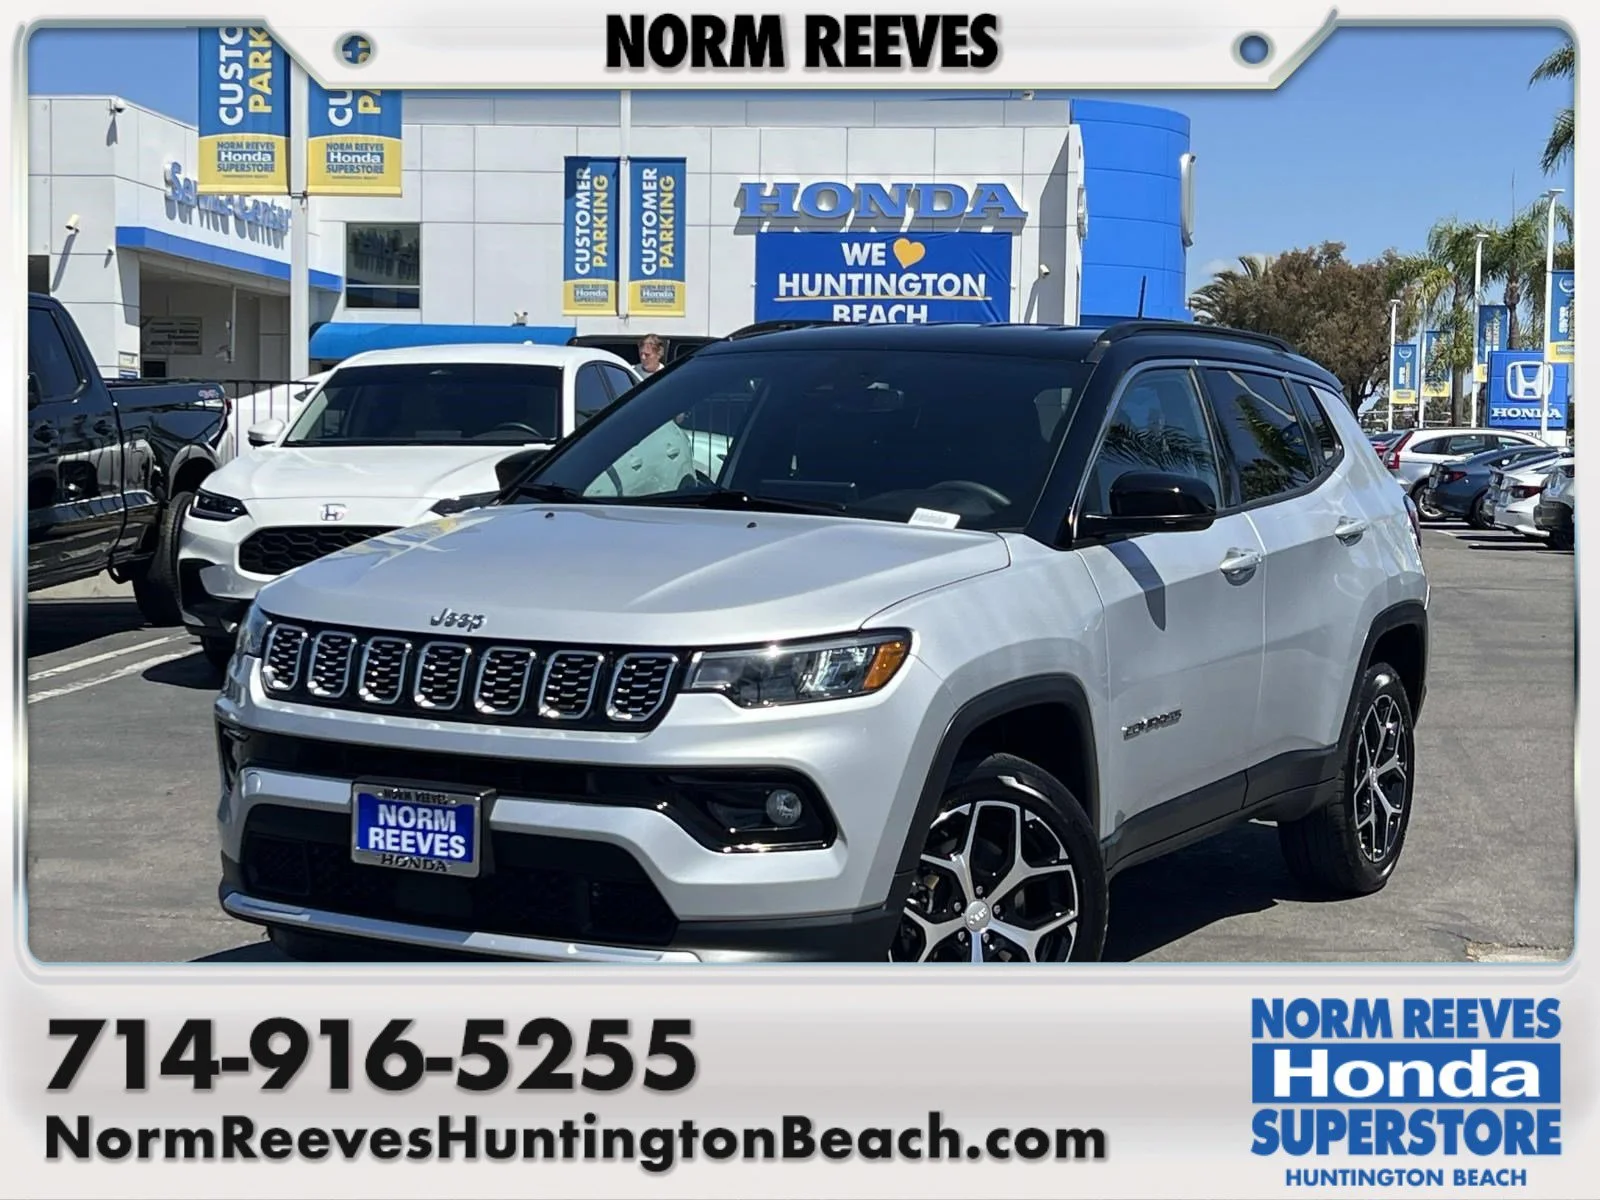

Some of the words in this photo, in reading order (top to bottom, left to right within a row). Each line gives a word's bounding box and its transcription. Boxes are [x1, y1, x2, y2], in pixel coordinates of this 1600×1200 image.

[217, 142, 244, 150] NORM
[246, 142, 275, 151] REEVES
[220, 151, 272, 162] Honda
[326, 143, 353, 151] NORM
[355, 143, 384, 151] REEVES
[217, 163, 275, 173] SUPERSTORE
[329, 152, 381, 163] Honda
[326, 164, 384, 174] SUPERSTORE
[739, 182, 1028, 219] HONDA
[575, 167, 591, 275] CUSTOMER
[593, 175, 608, 267] PARKING
[642, 168, 657, 275] CUSTOMER
[659, 175, 675, 268] PARKING
[841, 242, 886, 266] WE
[576, 287, 608, 297] Honda
[642, 288, 674, 298] Honda
[778, 273, 986, 298] HUNTINGTON
[833, 304, 928, 323] BEACH
[430, 608, 487, 632] Jeep
[378, 804, 456, 833] NORM
[368, 827, 466, 858] REEVES
[380, 853, 448, 872] HONDA
